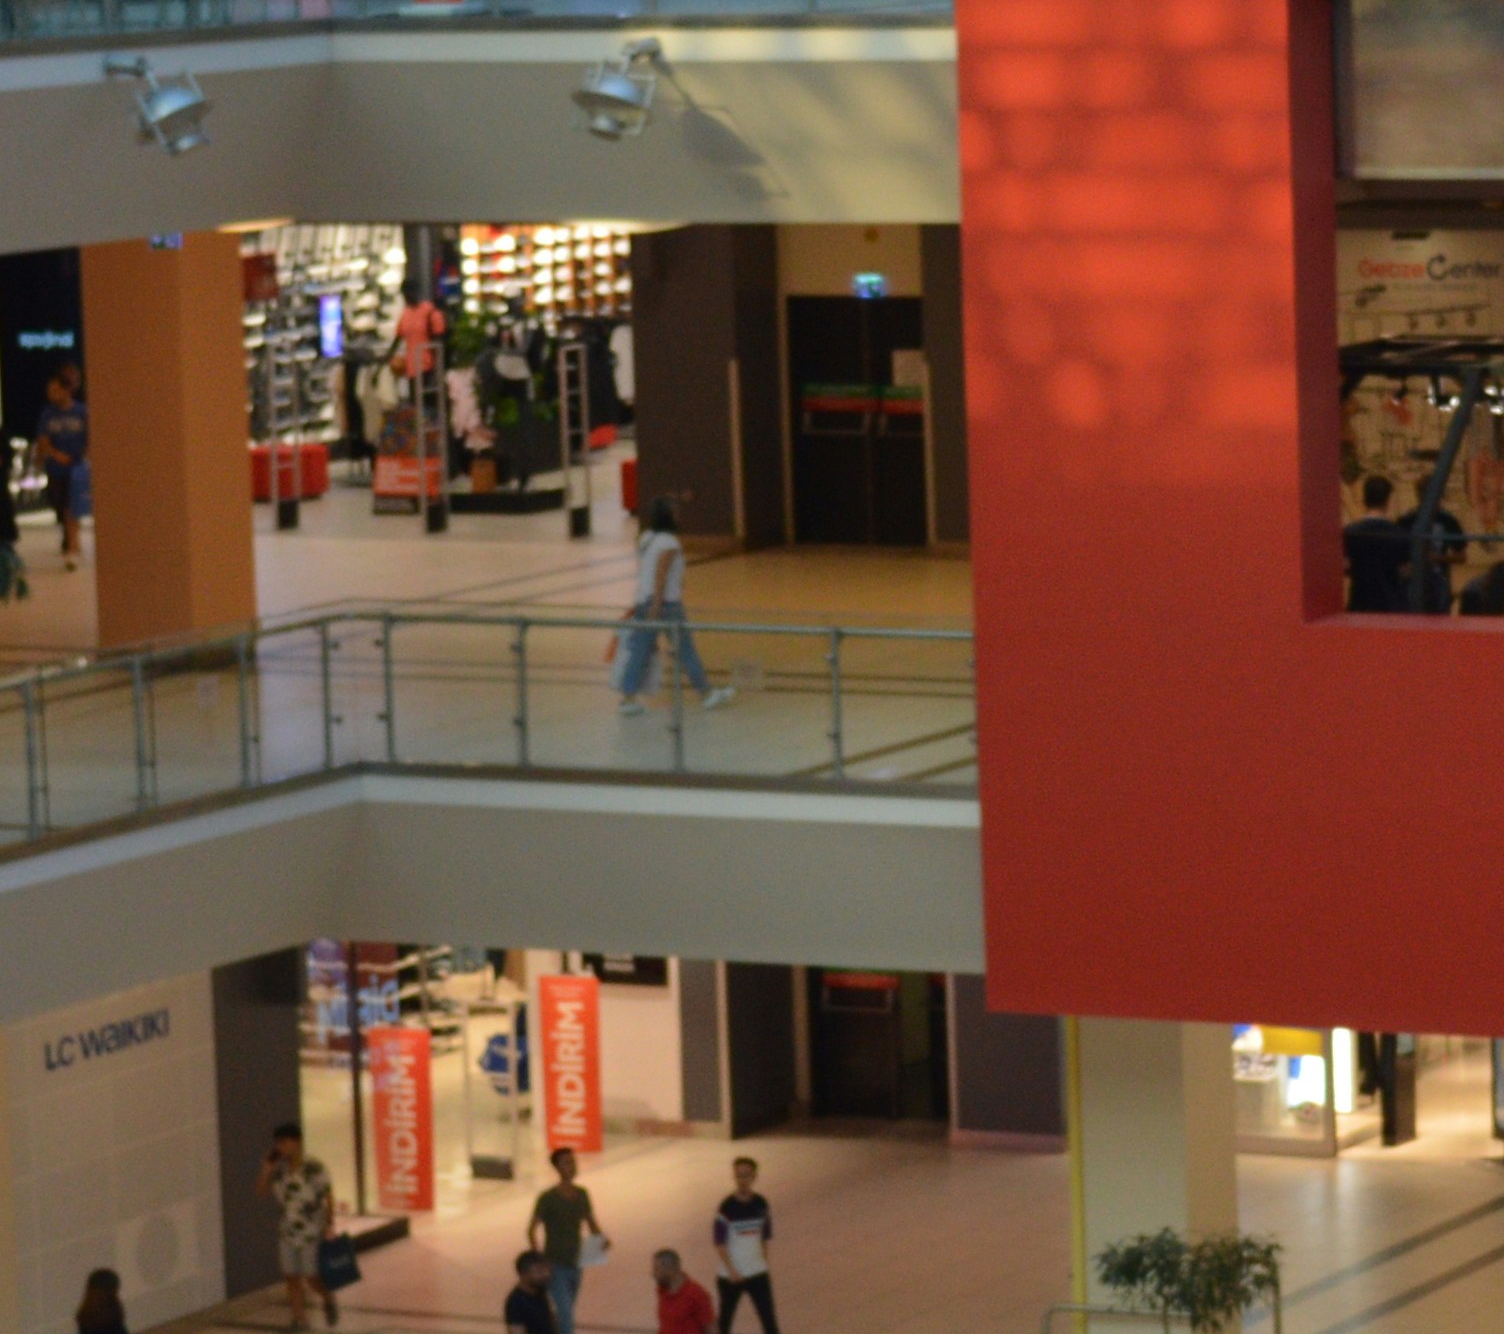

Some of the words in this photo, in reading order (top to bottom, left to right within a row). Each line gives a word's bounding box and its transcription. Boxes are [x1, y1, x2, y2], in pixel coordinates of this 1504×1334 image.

[44, 1035, 75, 1072] LC
[551, 999, 587, 1136] İNDİRİM
[384, 1052, 418, 1195] İNDİRİM
